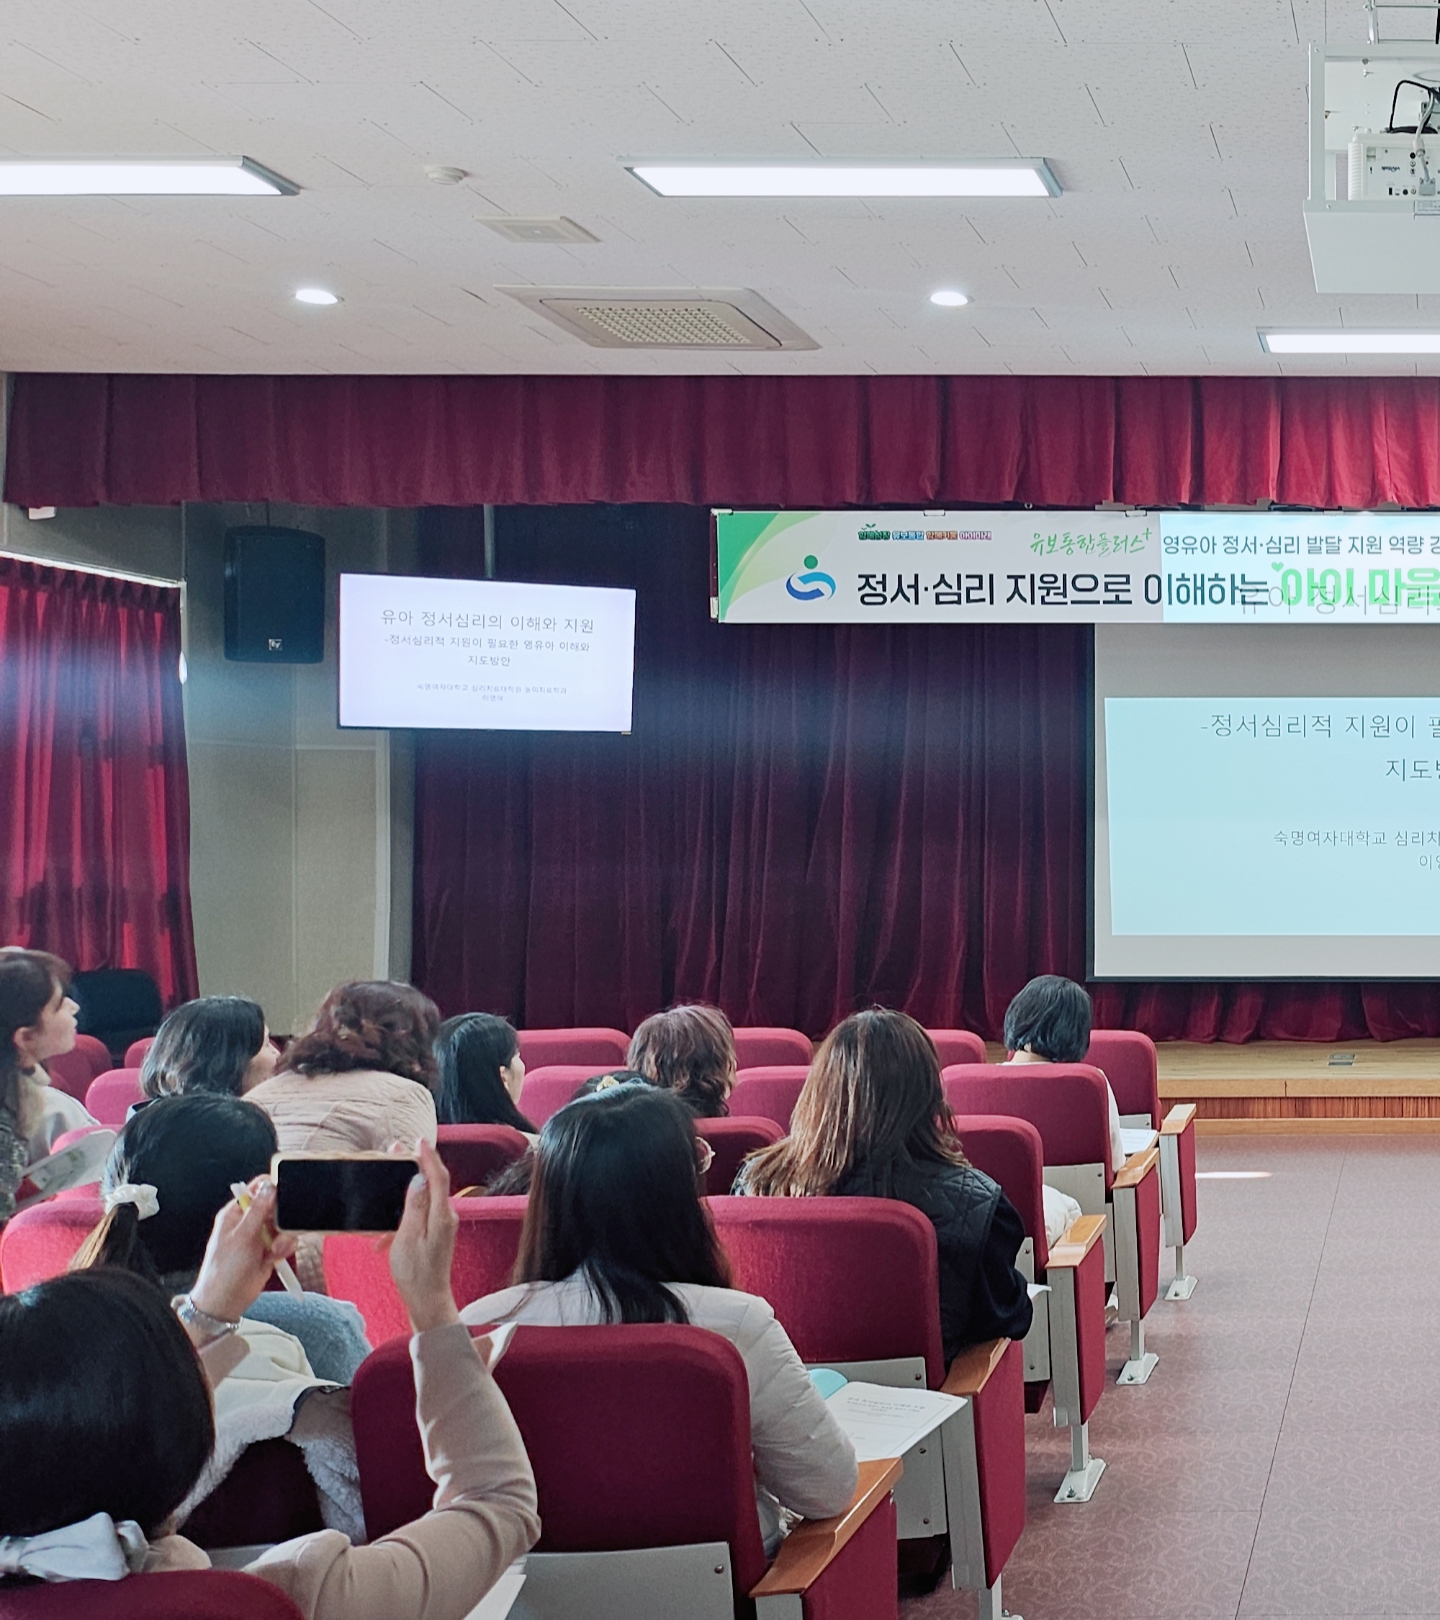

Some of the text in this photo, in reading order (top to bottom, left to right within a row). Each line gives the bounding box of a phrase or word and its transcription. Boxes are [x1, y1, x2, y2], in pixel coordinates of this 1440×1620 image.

[1163, 536, 1217, 555] 영유아
[1223, 536, 1299, 555] 정서·심리
[1307, 536, 1342, 554] 발달
[1348, 535, 1382, 555] 지원
[1389, 535, 1424, 555] 역량
[857, 573, 994, 606] 정서·심리
[1006, 573, 1132, 605] 지원으로
[1144, 573, 1269, 606] 이해하는
[1281, 568, 1354, 606] 아이
[381, 609, 594, 634] 유아 정서심리의 이해와 지원
[450, 637, 482, 649] 지원이
[487, 638, 519, 650] 필요한
[523, 639, 555, 651] 영유아
[559, 641, 590, 652] 이해와
[468, 655, 511, 667] 지도방안
[1345, 714, 1415, 739] 지원이
[1273, 829, 1388, 847] 숙명여자대학교
